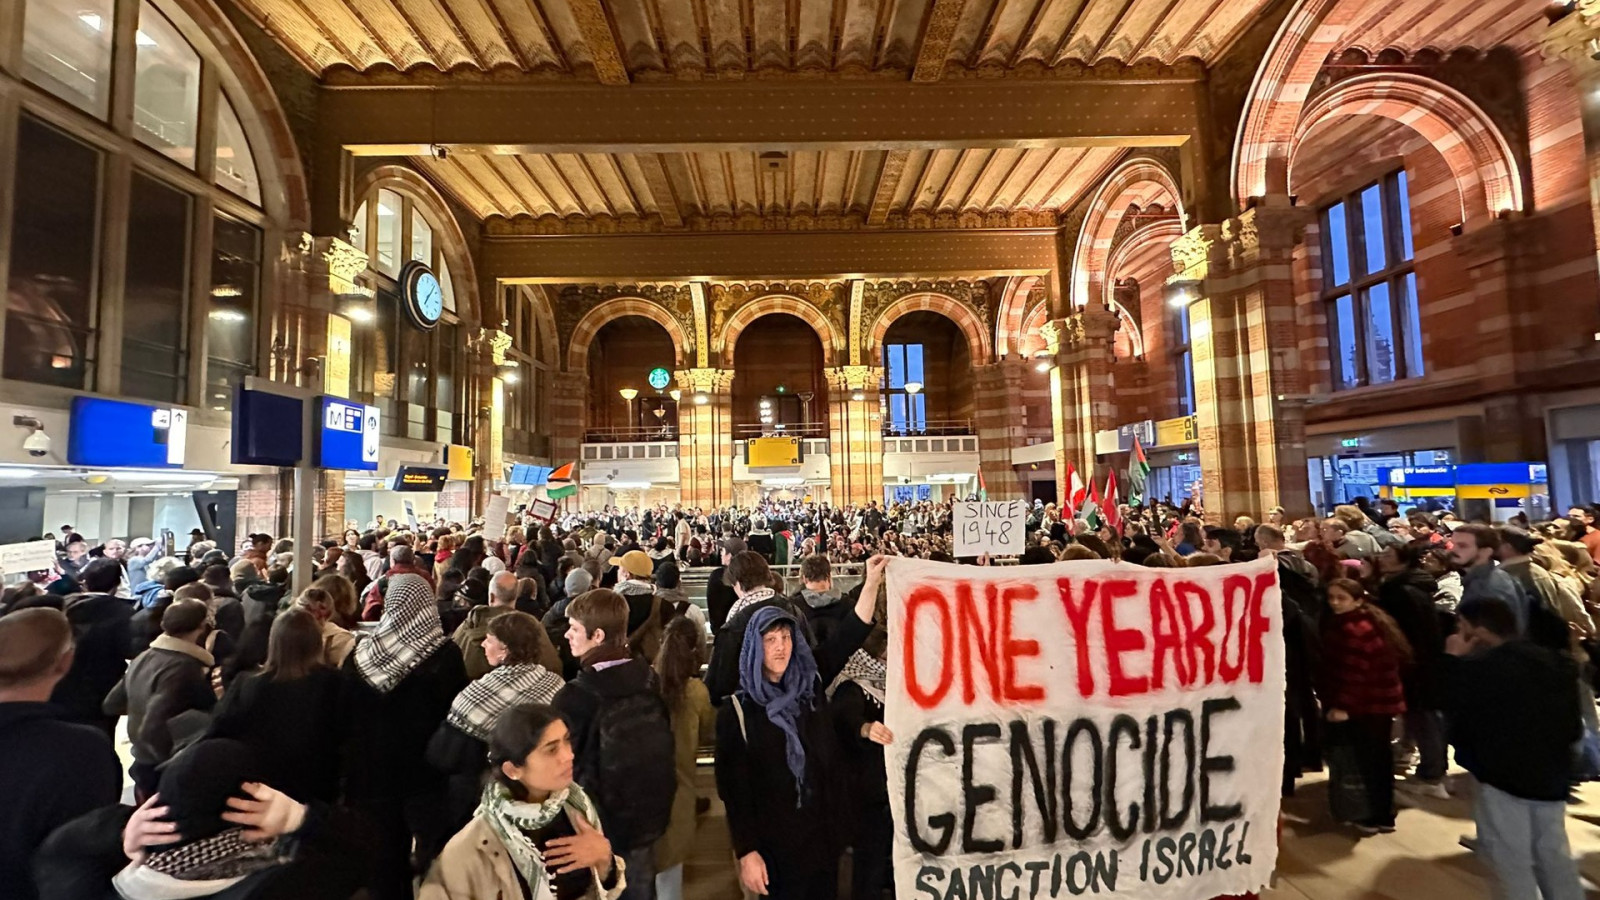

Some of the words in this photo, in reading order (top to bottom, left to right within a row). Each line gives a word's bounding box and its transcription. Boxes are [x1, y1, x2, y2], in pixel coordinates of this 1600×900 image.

[963, 521, 1012, 546] 1948
[964, 502, 1019, 518] SINCE
[903, 580, 1046, 711] ONE
[1056, 576, 1215, 699] YEAR
[1217, 571, 1277, 684] OF
[905, 695, 1242, 856] GENOCIDE
[914, 847, 1119, 900] SANCTION
[1138, 820, 1253, 885] ISRAEL
